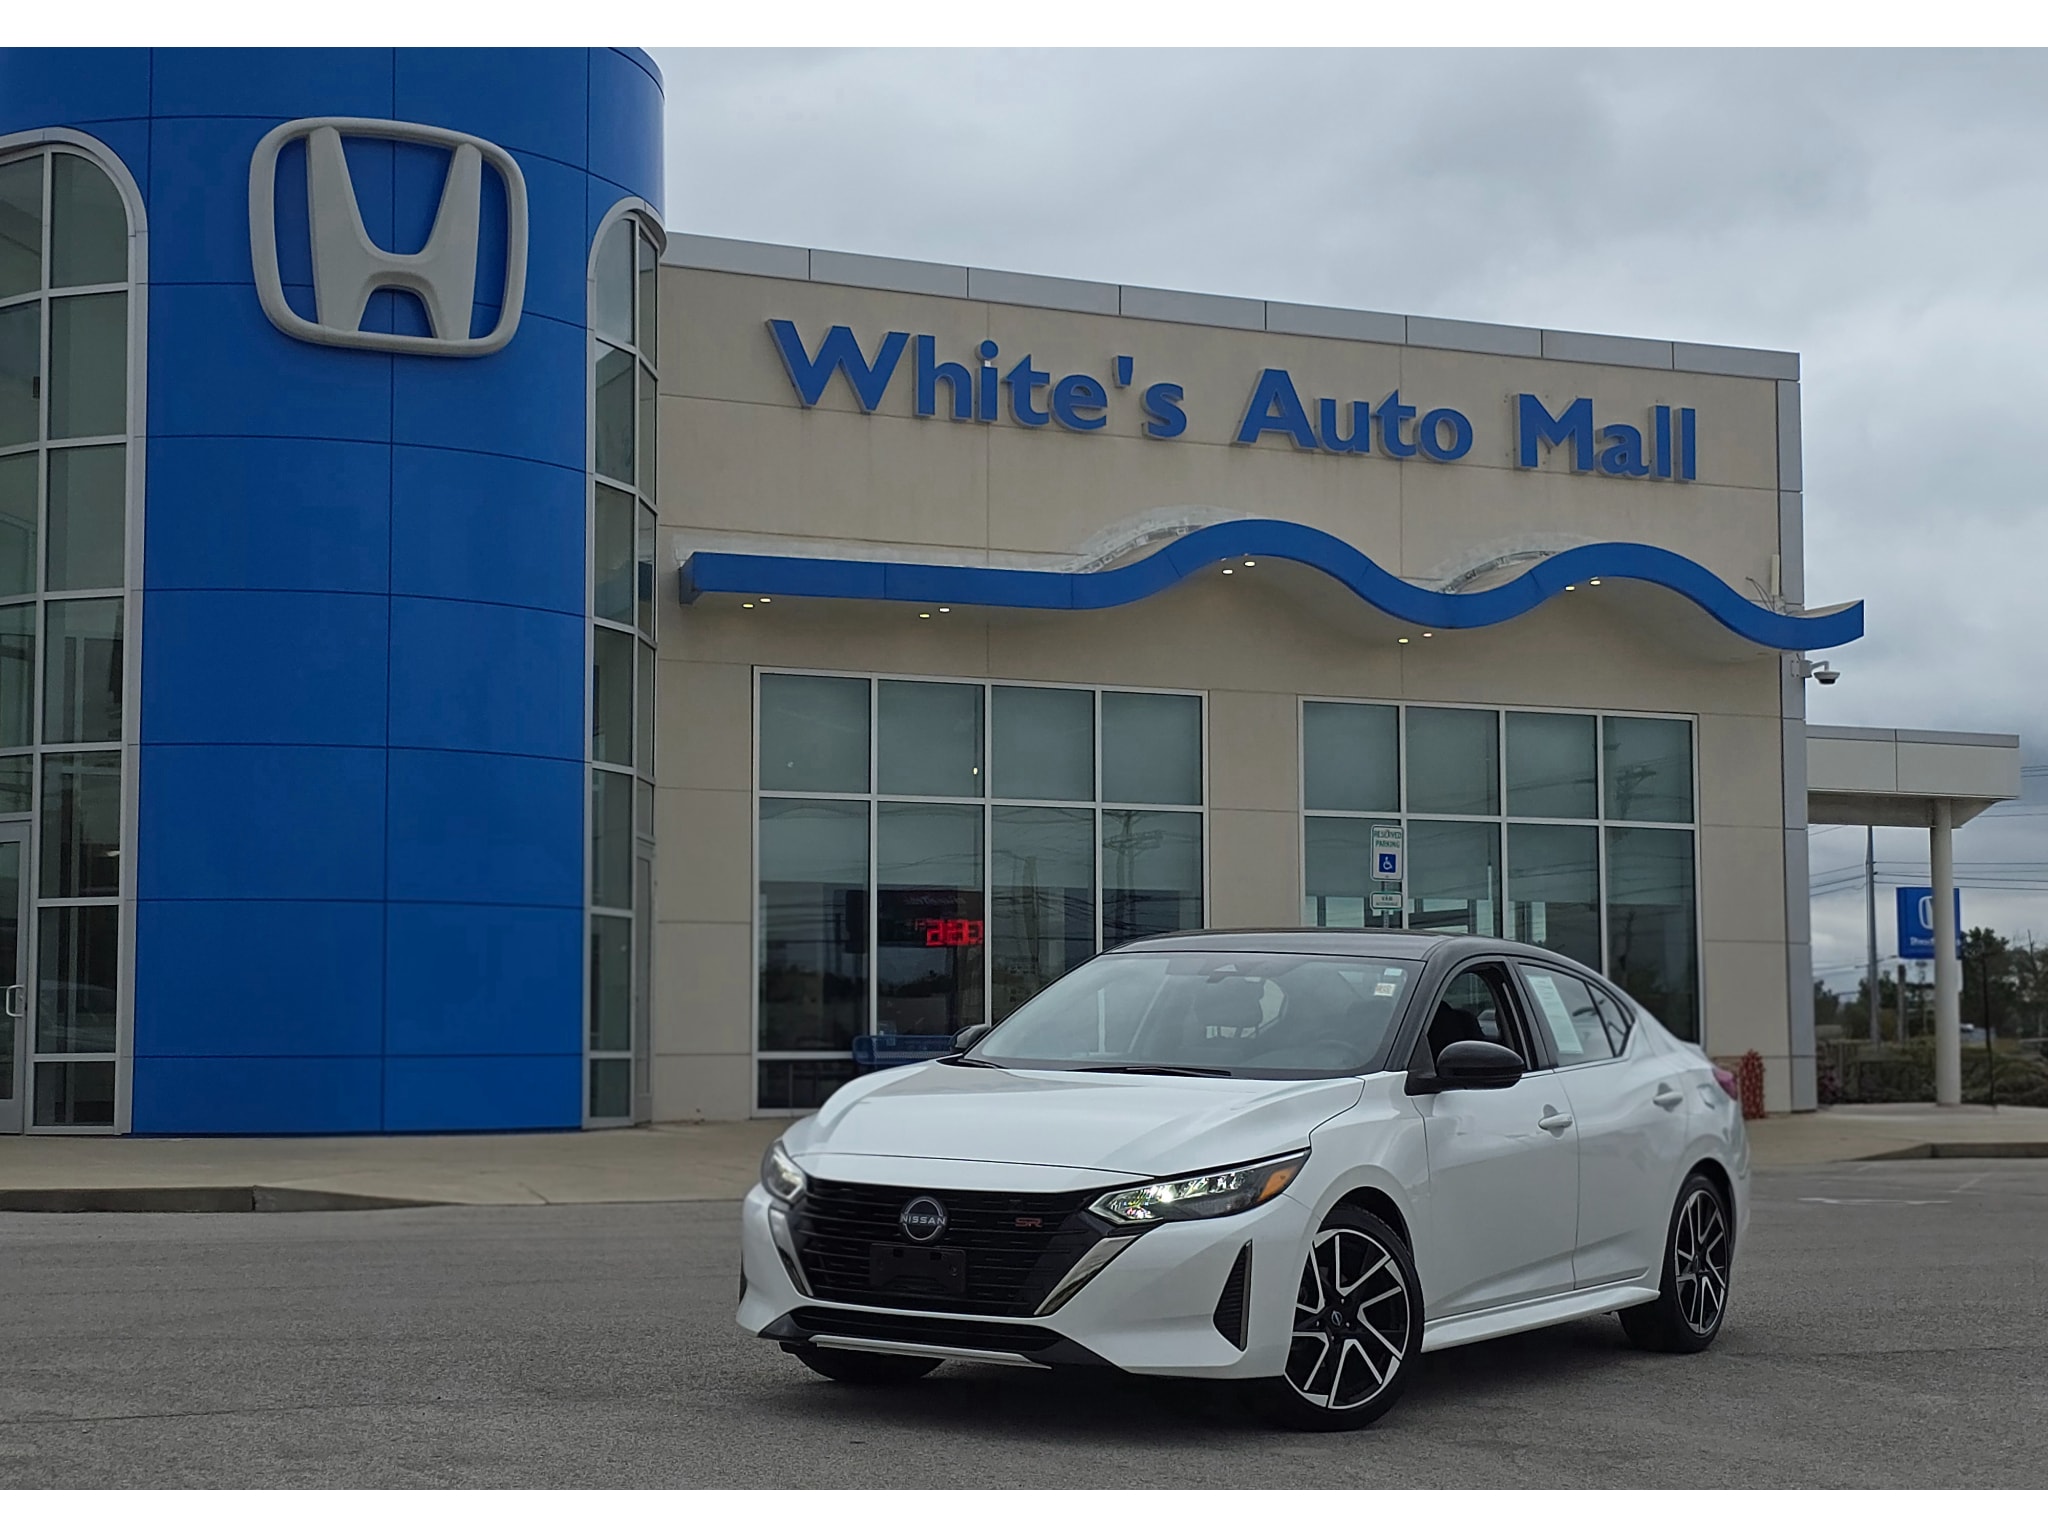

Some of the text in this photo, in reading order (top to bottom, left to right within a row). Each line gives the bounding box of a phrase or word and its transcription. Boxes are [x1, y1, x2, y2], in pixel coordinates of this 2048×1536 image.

[765, 318, 1697, 483] White's Auto Mall
[1373, 830, 1402, 839] RESERVED
[1375, 840, 1400, 849] PARKING
[900, 1213, 947, 1226] NISSAN
[1014, 1217, 1043, 1228] SR
